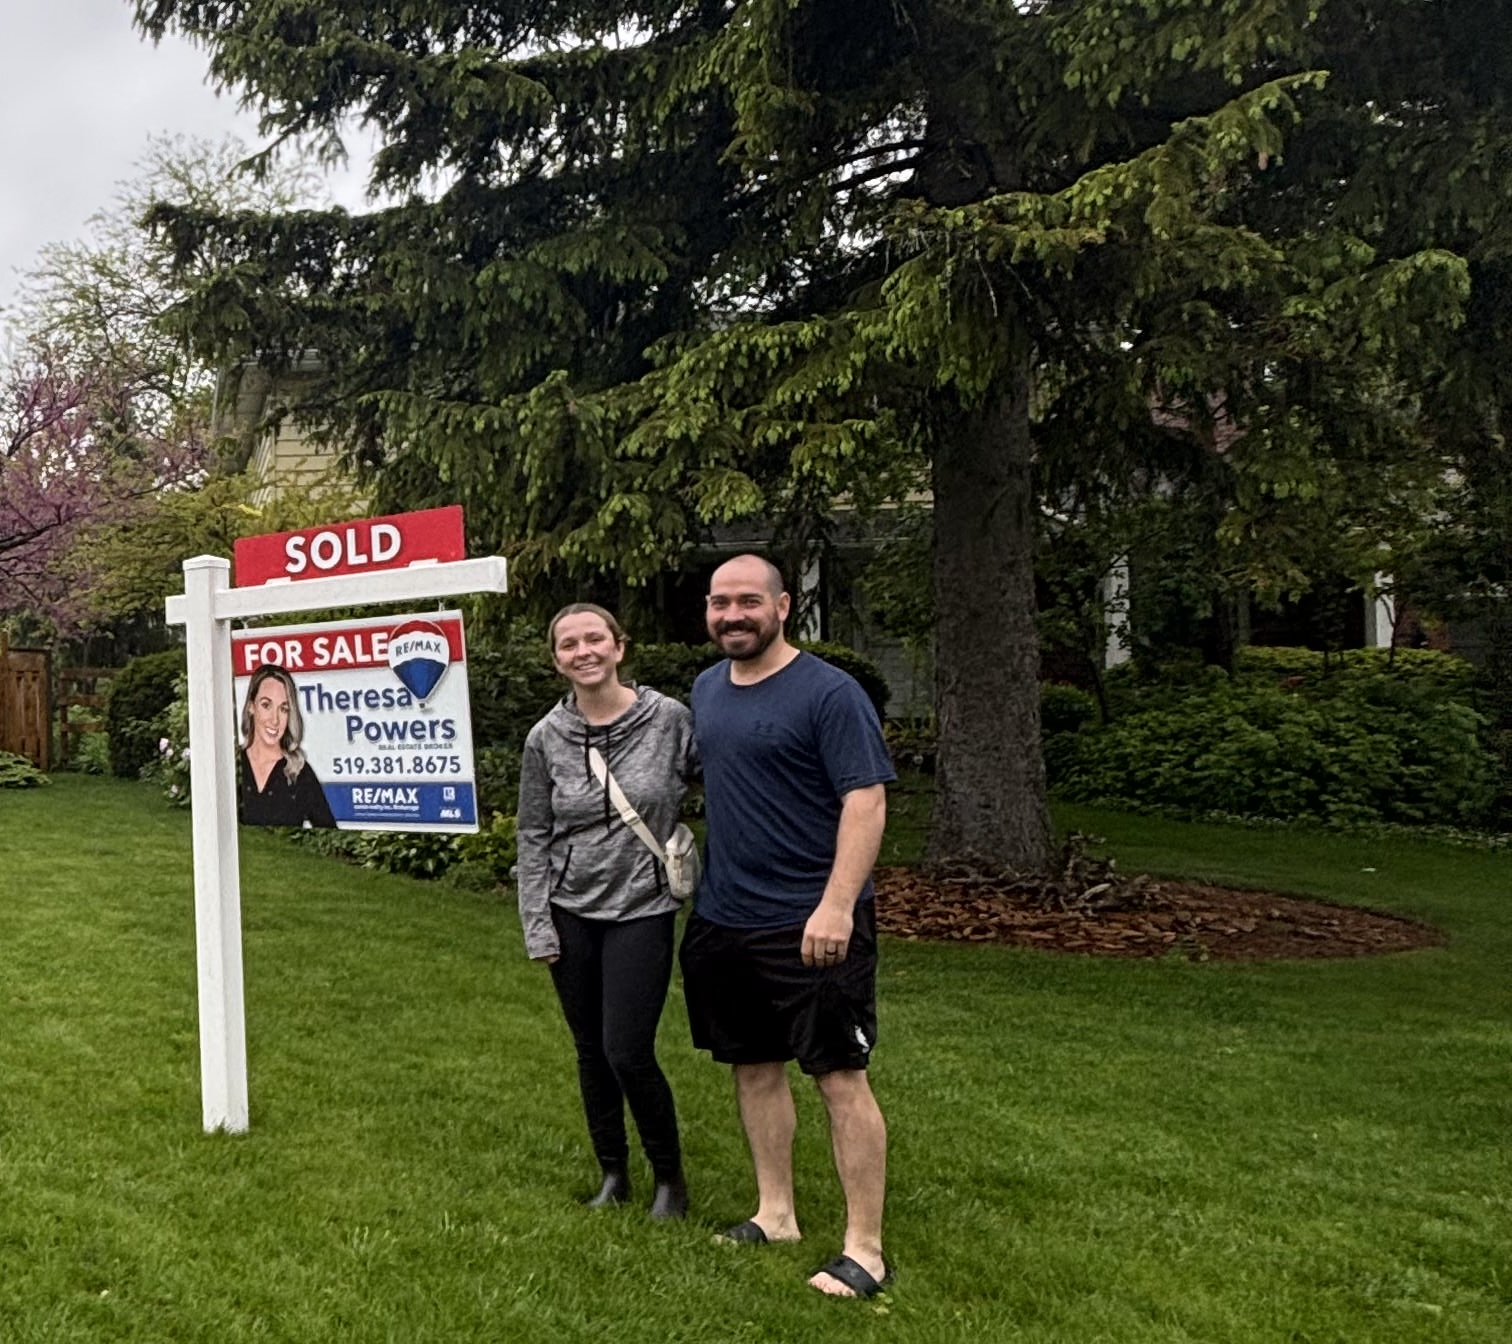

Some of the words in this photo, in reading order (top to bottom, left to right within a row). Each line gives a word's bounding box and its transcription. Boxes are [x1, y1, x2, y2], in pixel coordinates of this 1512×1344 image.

[285, 524, 402, 573] SOLD
[244, 640, 304, 671] FOR
[313, 632, 389, 666] SALE
[395, 641, 441, 657] RE/MAX
[299, 683, 413, 711] Theresa
[345, 715, 456, 742] Powers
[332, 756, 461, 775] 519.381.8675
[352, 787, 419, 804] RE/MAX
